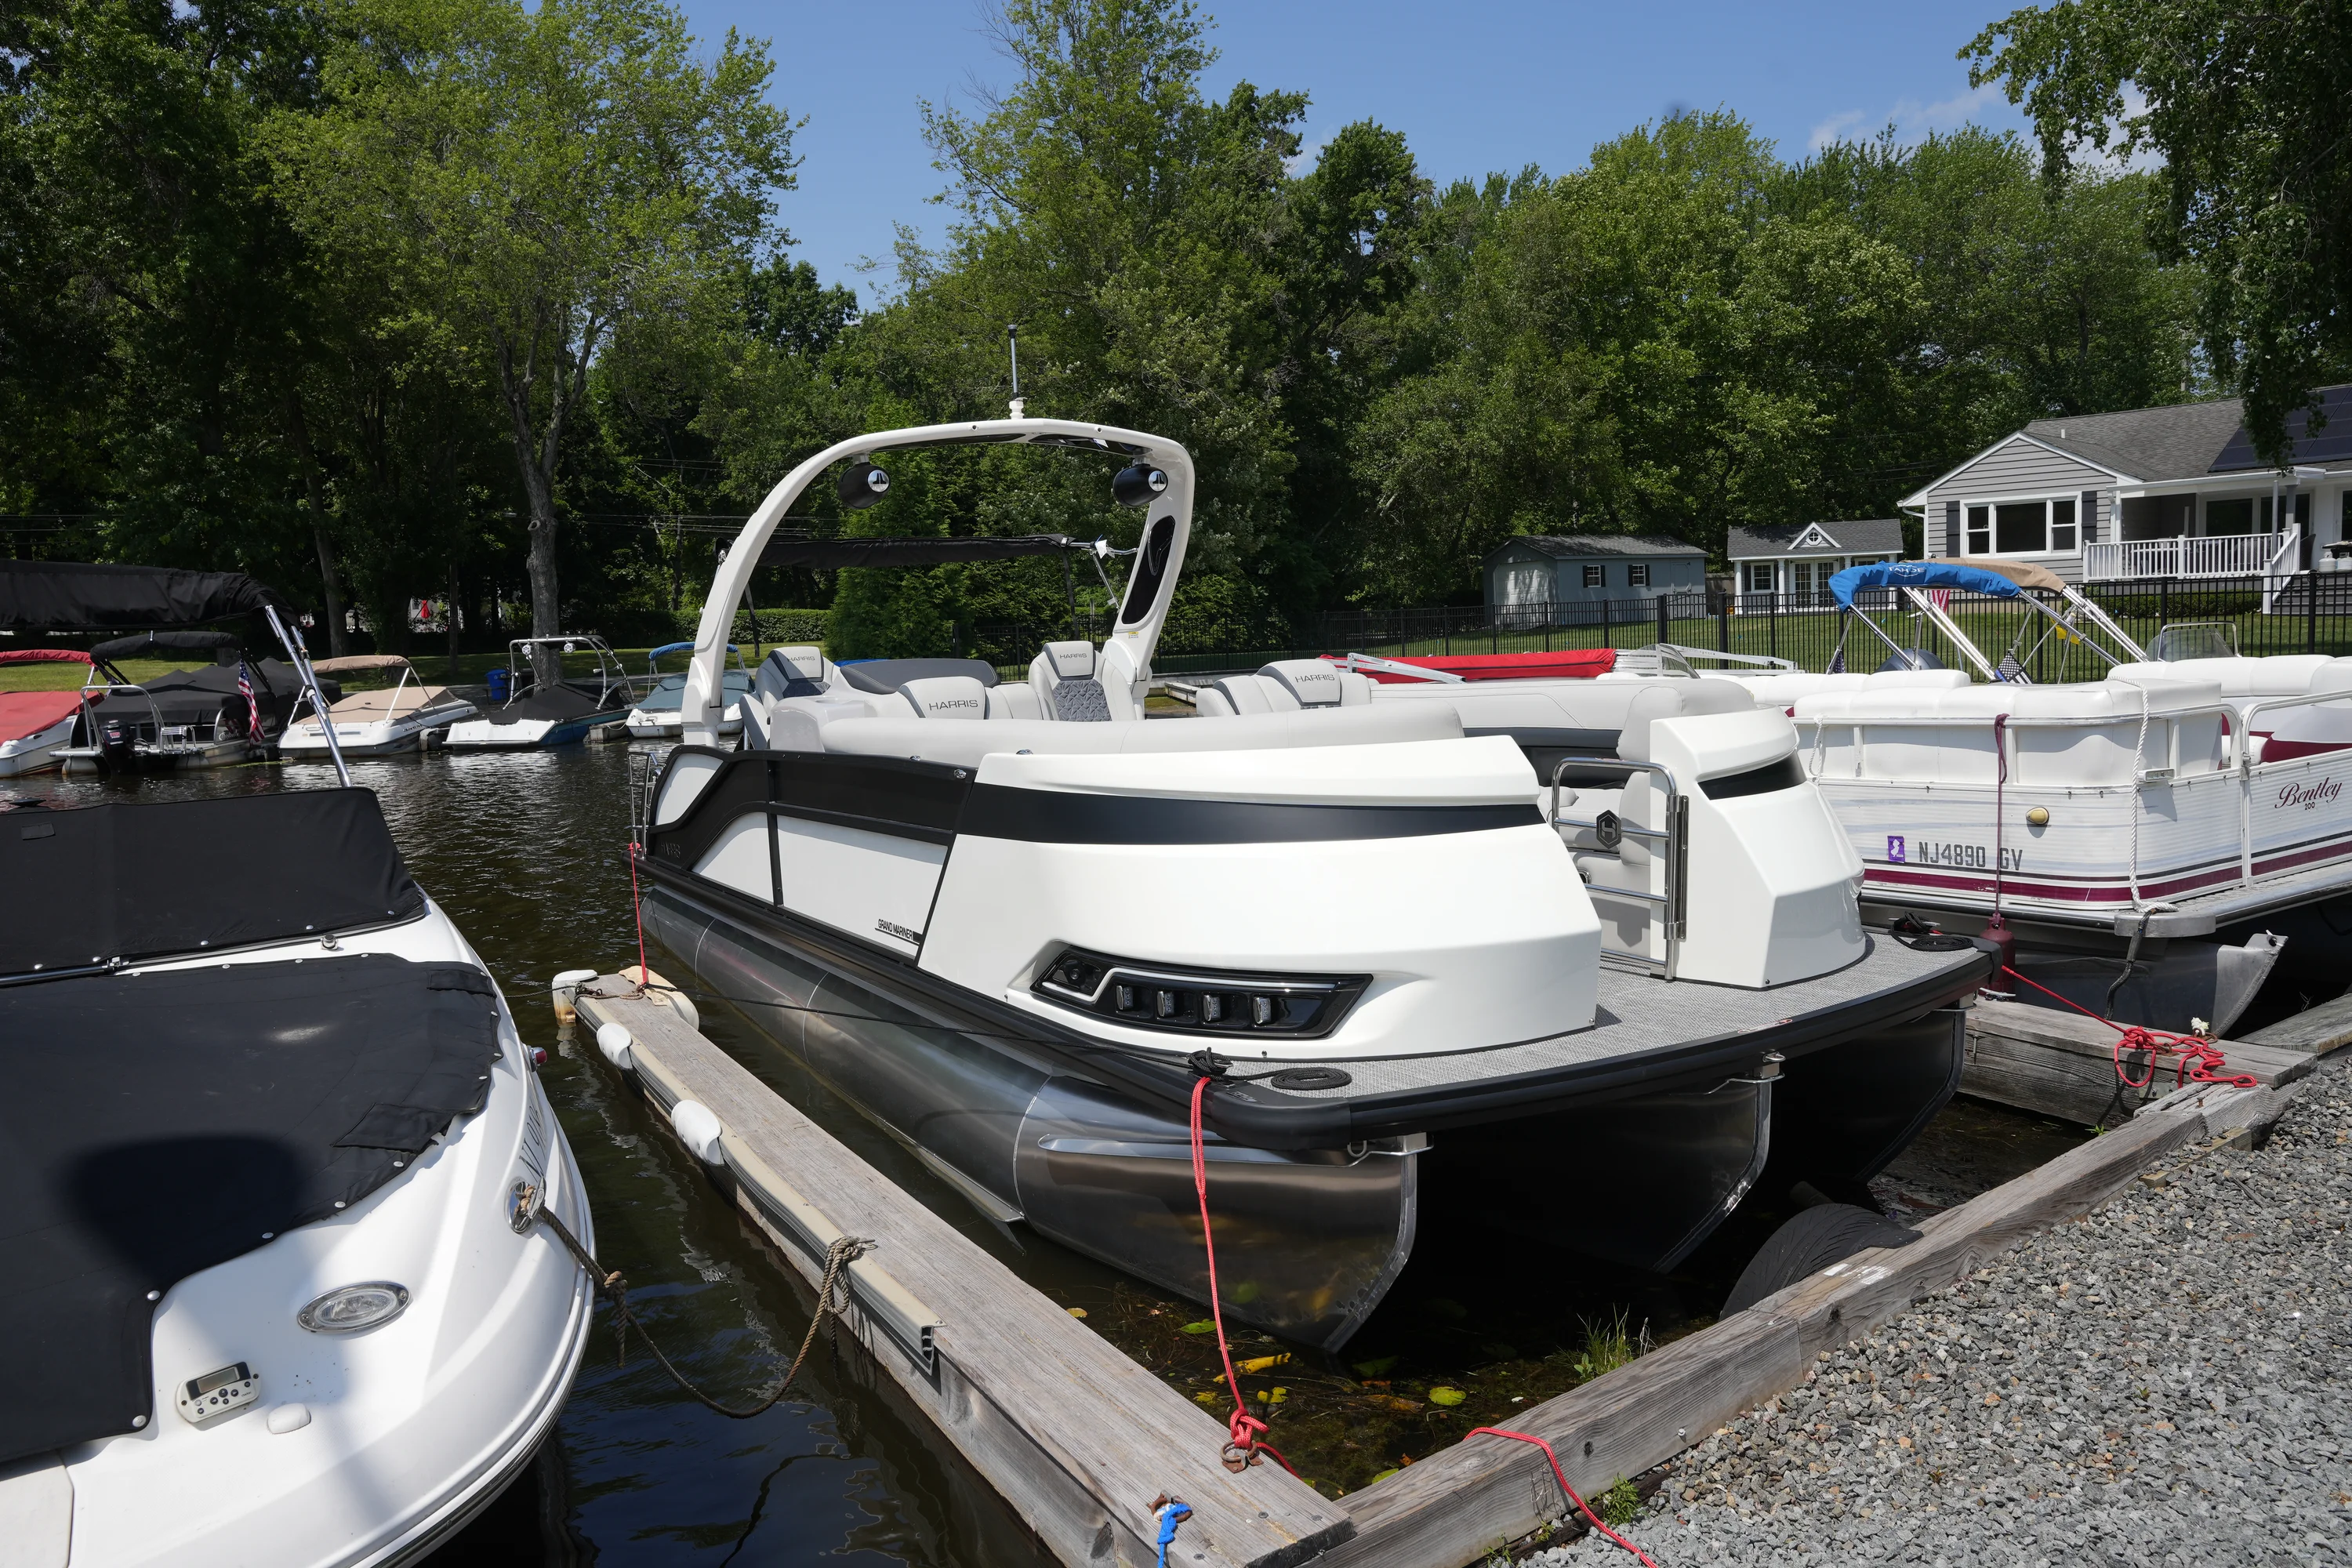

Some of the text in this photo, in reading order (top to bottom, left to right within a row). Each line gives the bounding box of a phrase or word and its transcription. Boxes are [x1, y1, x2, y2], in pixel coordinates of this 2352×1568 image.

[1294, 673, 1335, 683] HARRIS
[928, 699, 978, 711] HARRIS
[2274, 776, 2343, 808] Bentley
[2305, 801, 2316, 811] 200
[1918, 841, 2024, 871] NJ4890 GV
[878, 918, 913, 941] GRAND MARINER
